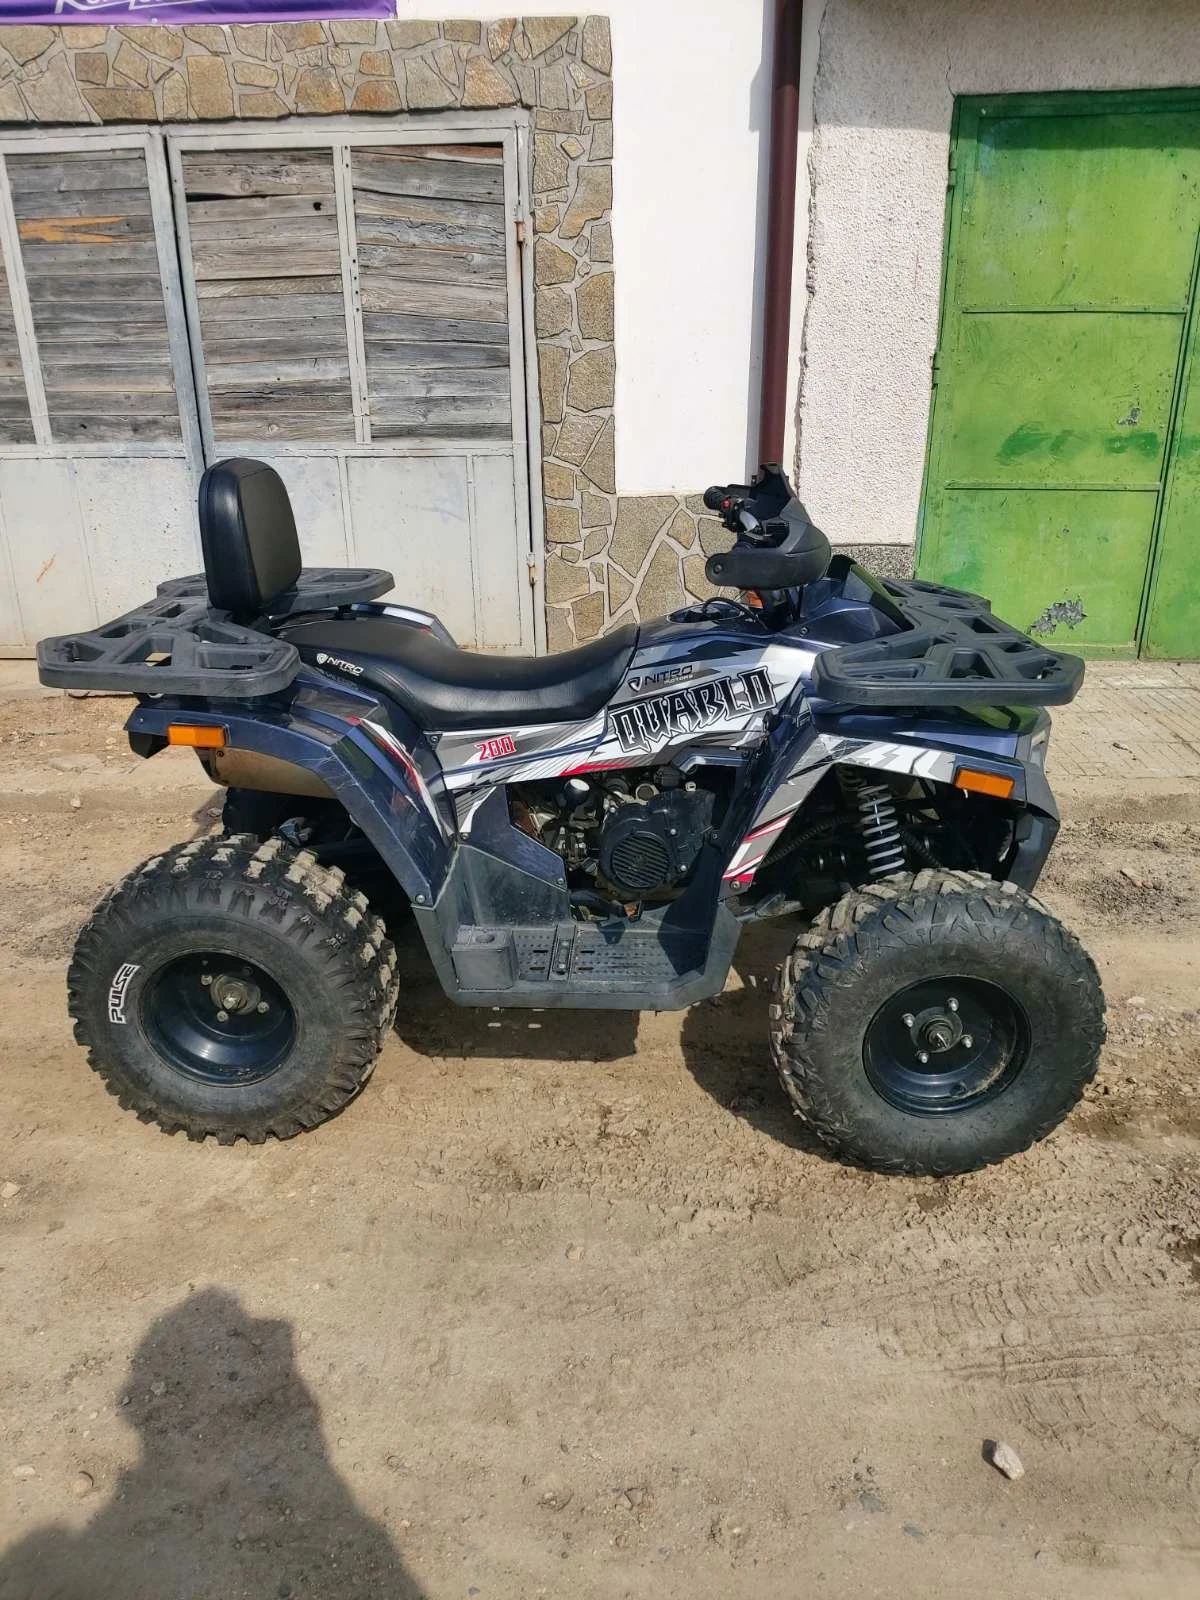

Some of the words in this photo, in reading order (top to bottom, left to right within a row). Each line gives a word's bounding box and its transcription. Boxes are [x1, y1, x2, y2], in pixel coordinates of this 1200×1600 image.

[326, 656, 364, 674] NITRO
[645, 664, 693, 685] NITRO
[610, 665, 778, 753] QUABLO
[476, 734, 517, 761] 200
[108, 963, 141, 1024] PULSE
